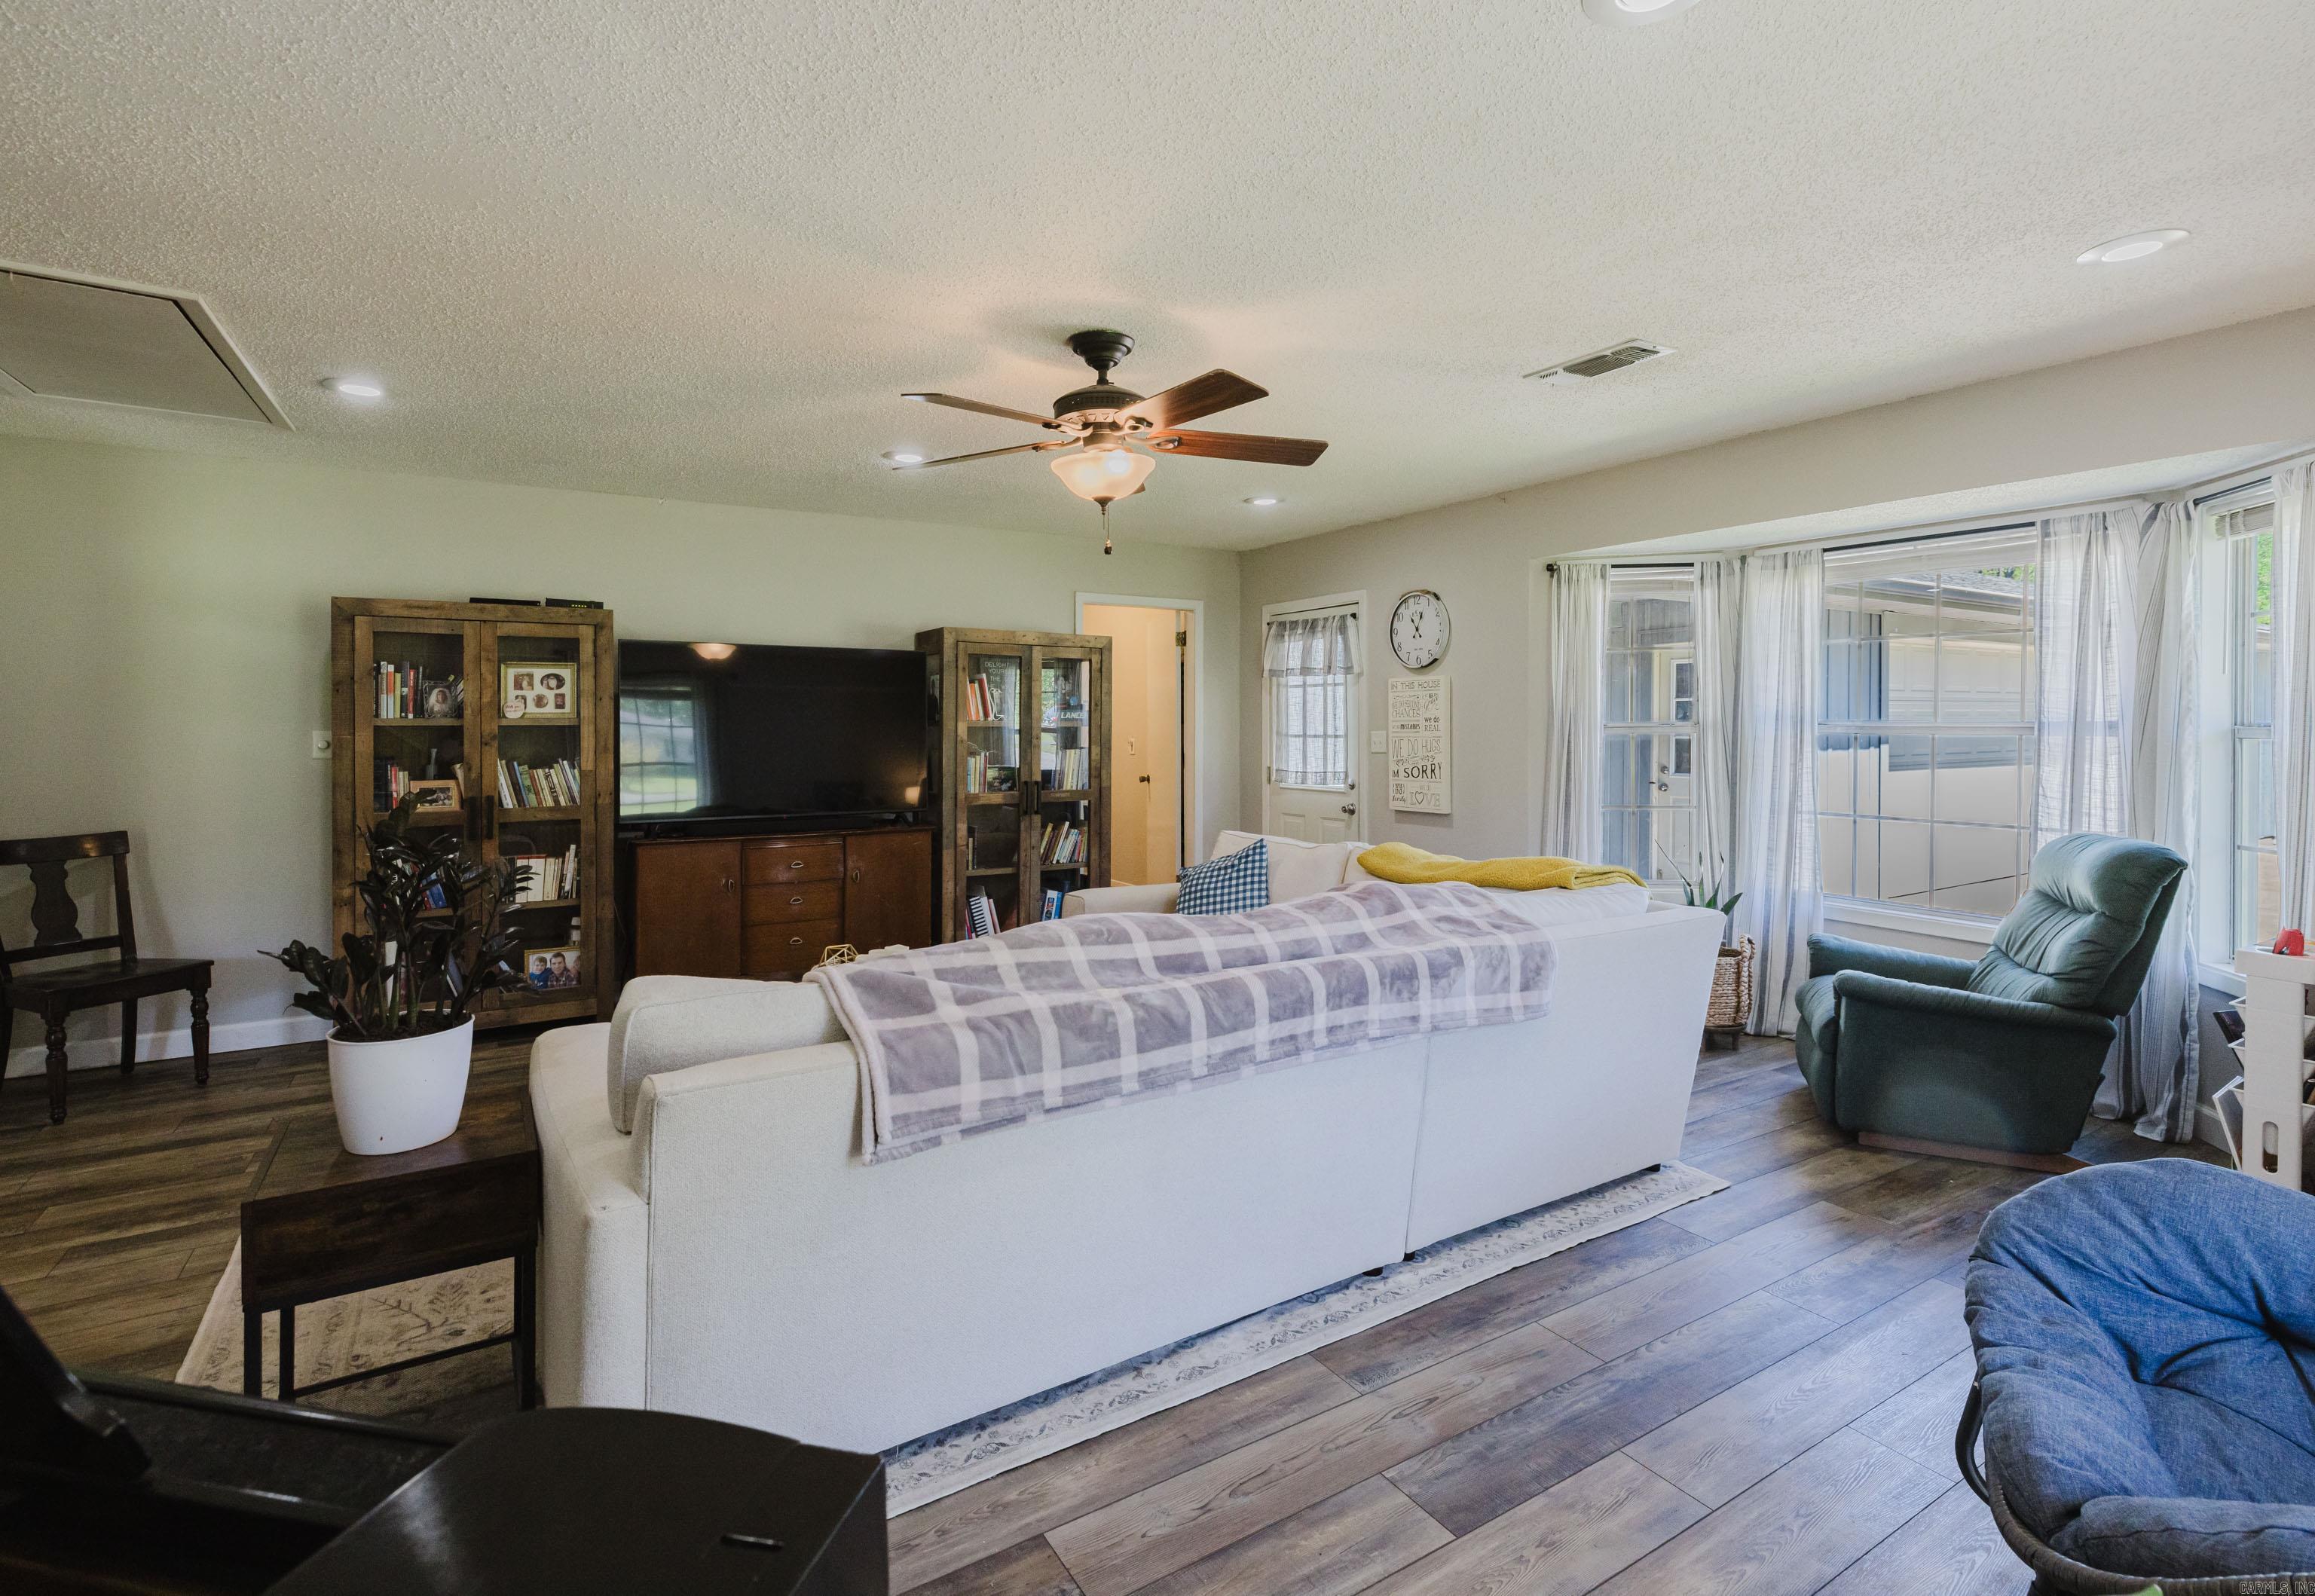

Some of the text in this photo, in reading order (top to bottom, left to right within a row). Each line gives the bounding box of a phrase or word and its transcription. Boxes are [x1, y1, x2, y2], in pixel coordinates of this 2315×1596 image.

[1414, 595, 1421, 605] 12
[1427, 598, 1430, 607] 1
[1396, 612, 1404, 622] 10
[1435, 607, 1440, 617] 2
[1393, 627, 1399, 637] 9
[1397, 642, 1402, 652] 8
[1406, 652, 1411, 662] 7
[1428, 650, 1433, 659] 5
[1416, 655, 1422, 665] 6
[1400, 681, 1415, 689] THIS
[1417, 680, 1441, 689] HOUSE
[1392, 708, 1420, 718] CHANCES
[1433, 715, 1440, 723] do
[1391, 738, 1441, 759] WE DO HUGS
[1403, 762, 1442, 780] SORRY
